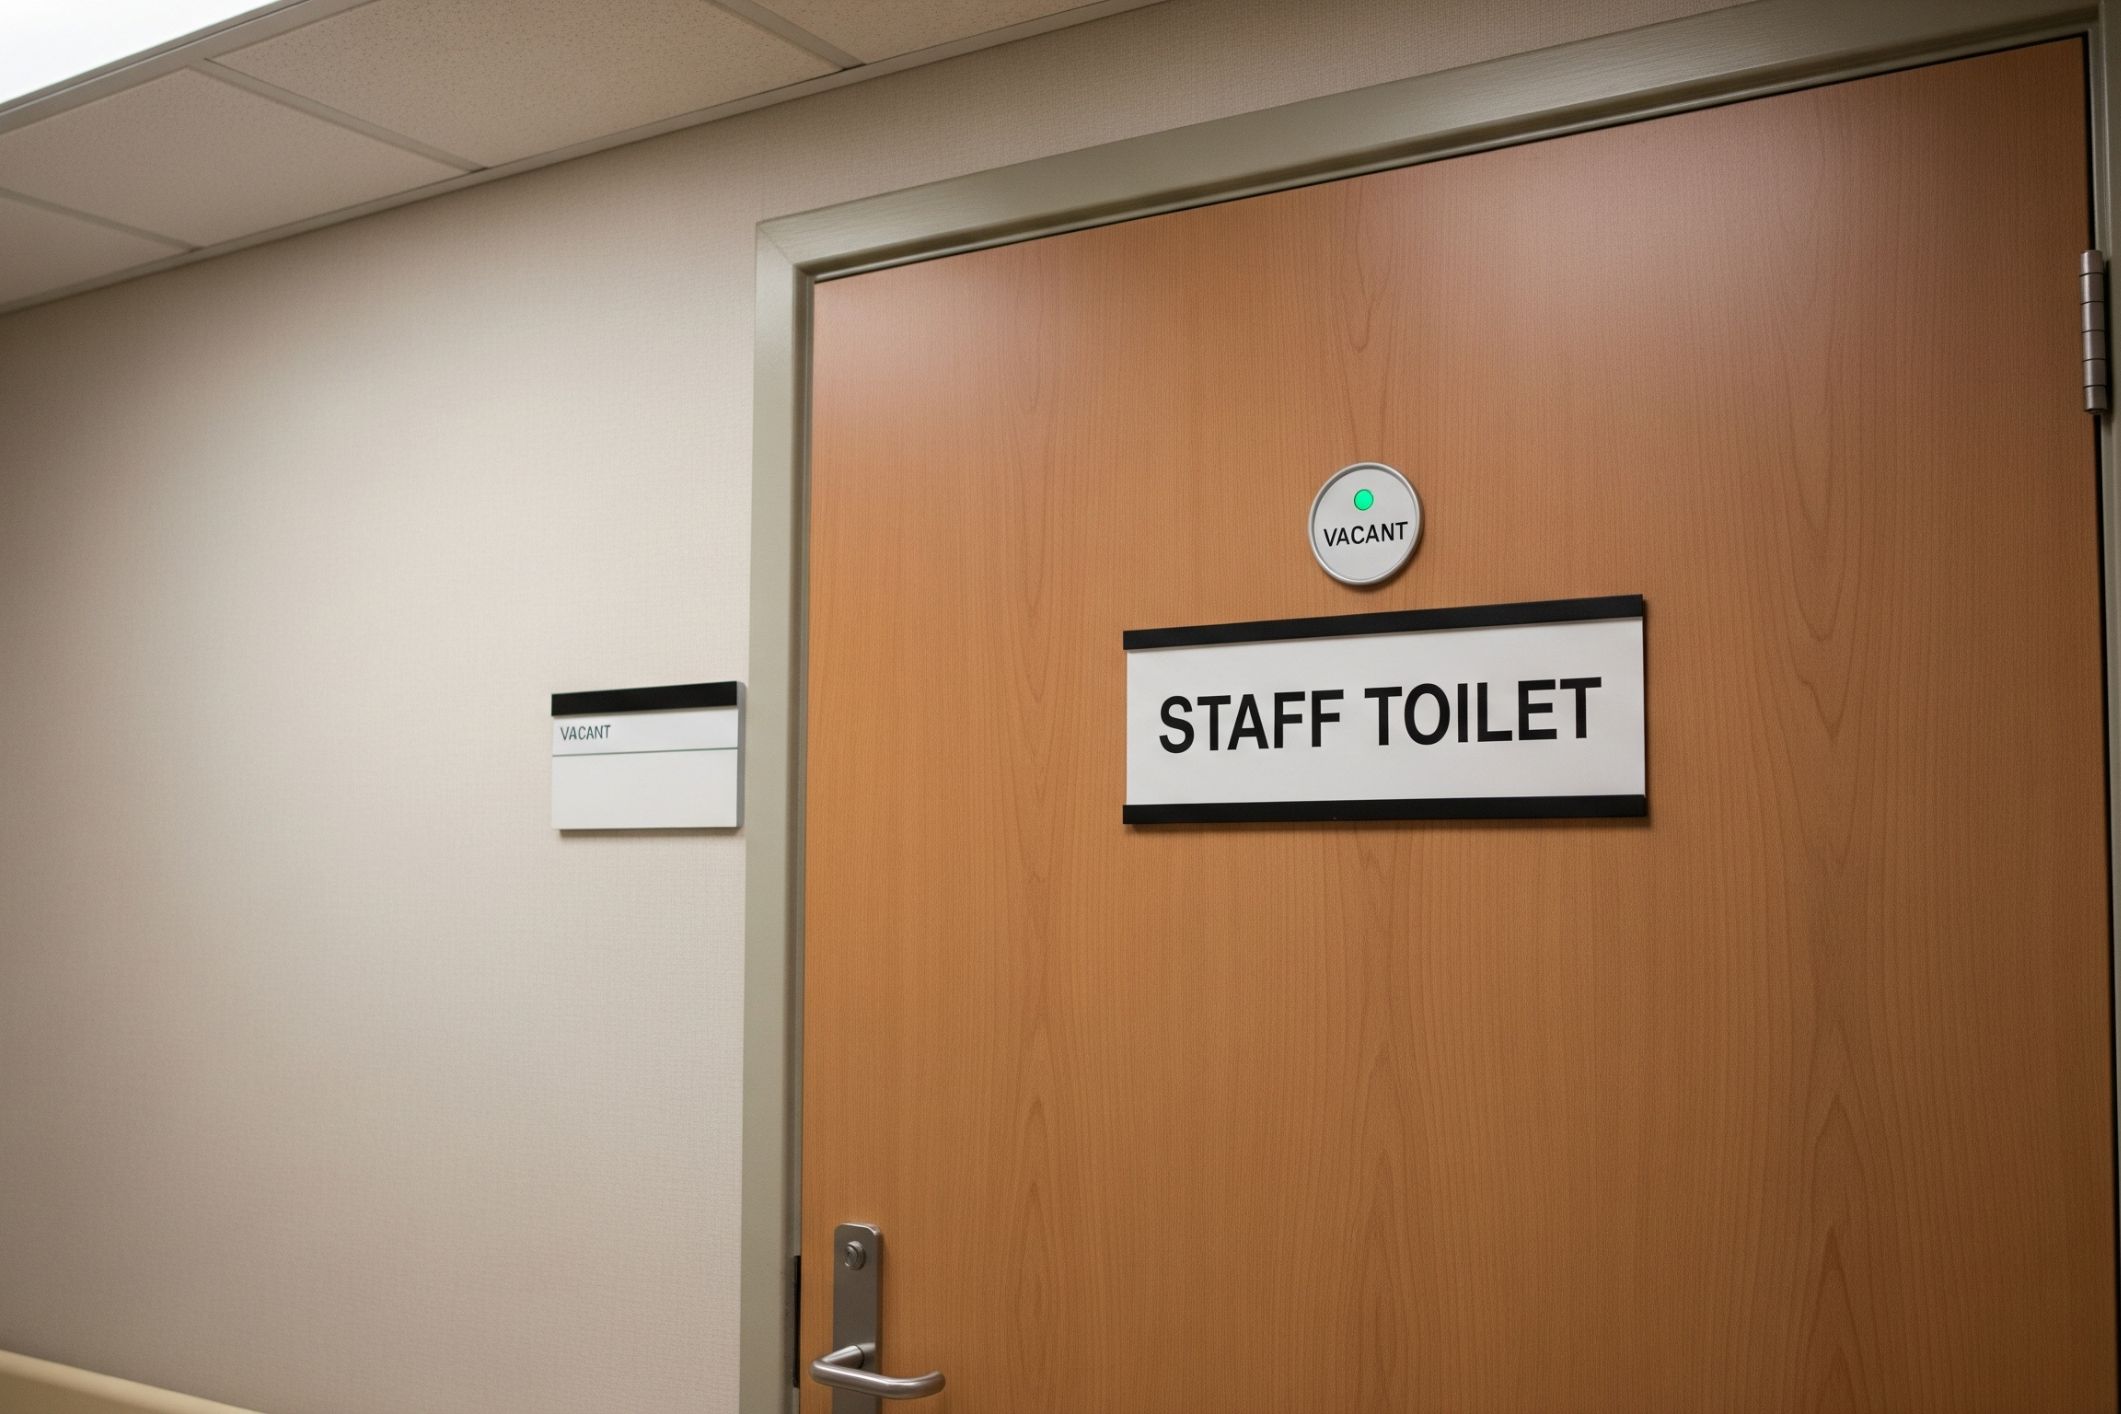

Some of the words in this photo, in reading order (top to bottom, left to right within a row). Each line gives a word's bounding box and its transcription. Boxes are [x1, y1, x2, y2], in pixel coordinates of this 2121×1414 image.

[1323, 521, 1408, 547] VACANT
[1159, 689, 1344, 754] STAFF
[1364, 676, 1602, 746] TOILET
[560, 725, 611, 741] VACANT
